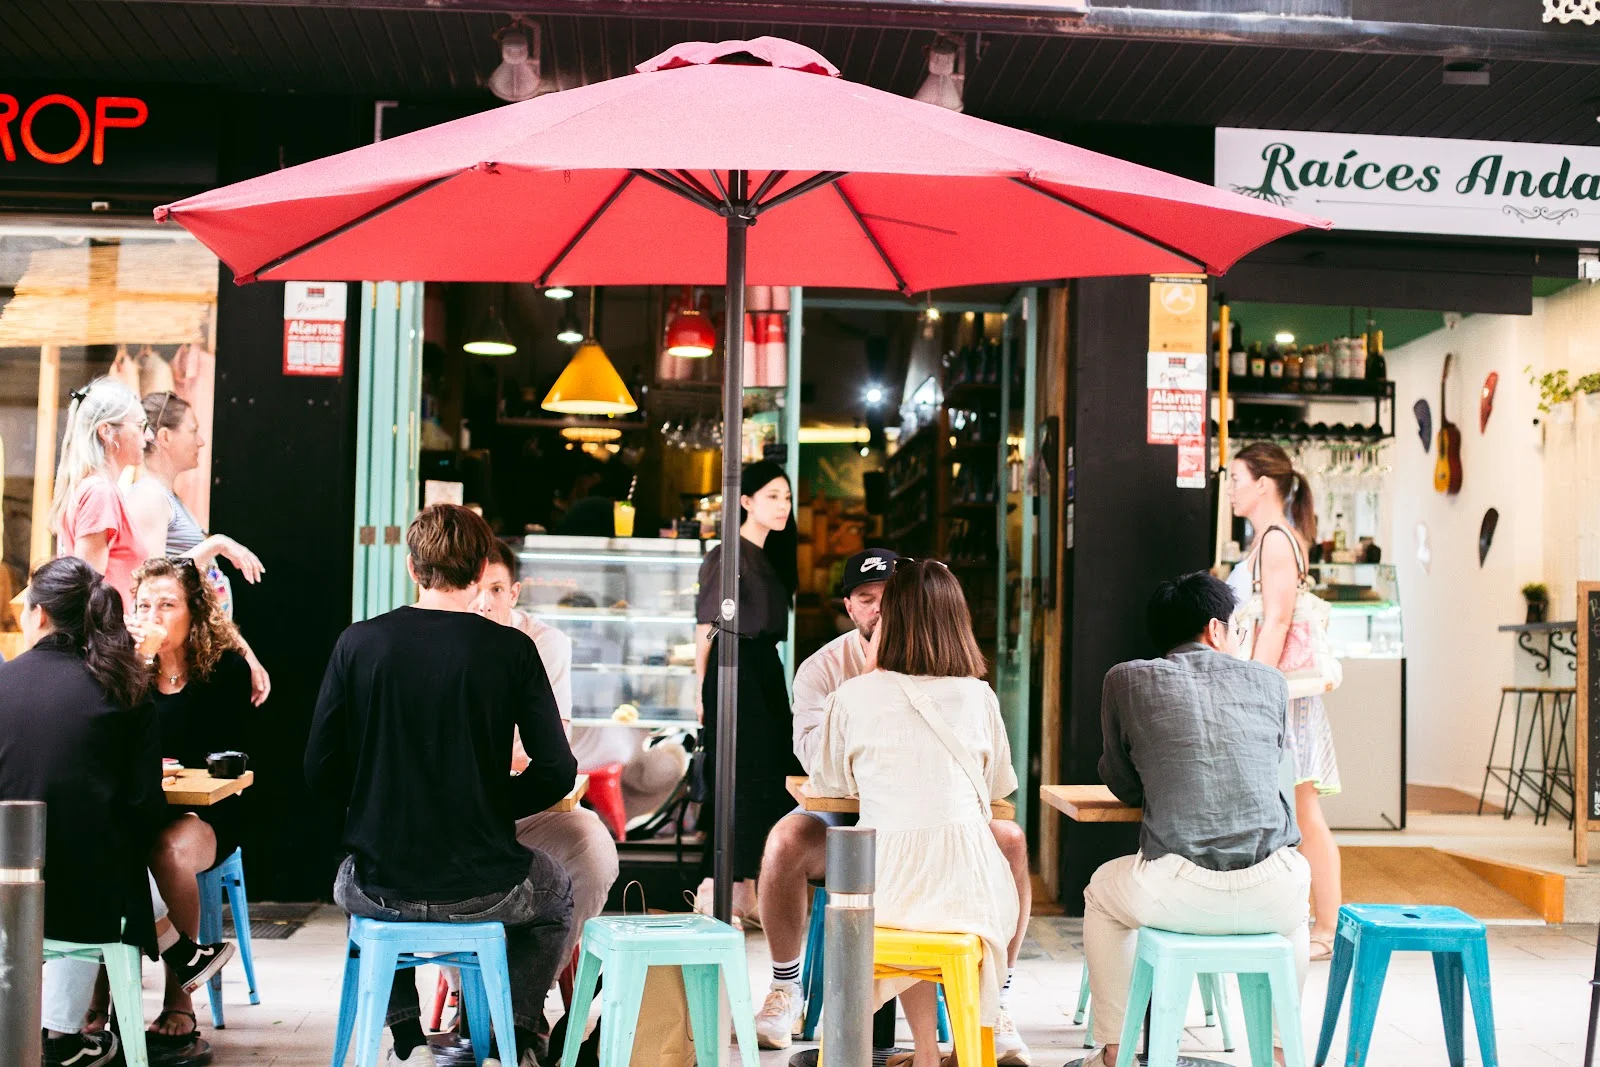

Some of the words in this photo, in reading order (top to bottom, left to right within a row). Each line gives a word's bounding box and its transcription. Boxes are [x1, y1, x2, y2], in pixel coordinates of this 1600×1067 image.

[1260, 142, 1441, 193] Raíces
[1455, 155, 1600, 201] Anda
[288, 320, 342, 335] Alarma
[1152, 390, 1202, 405] Alarma
